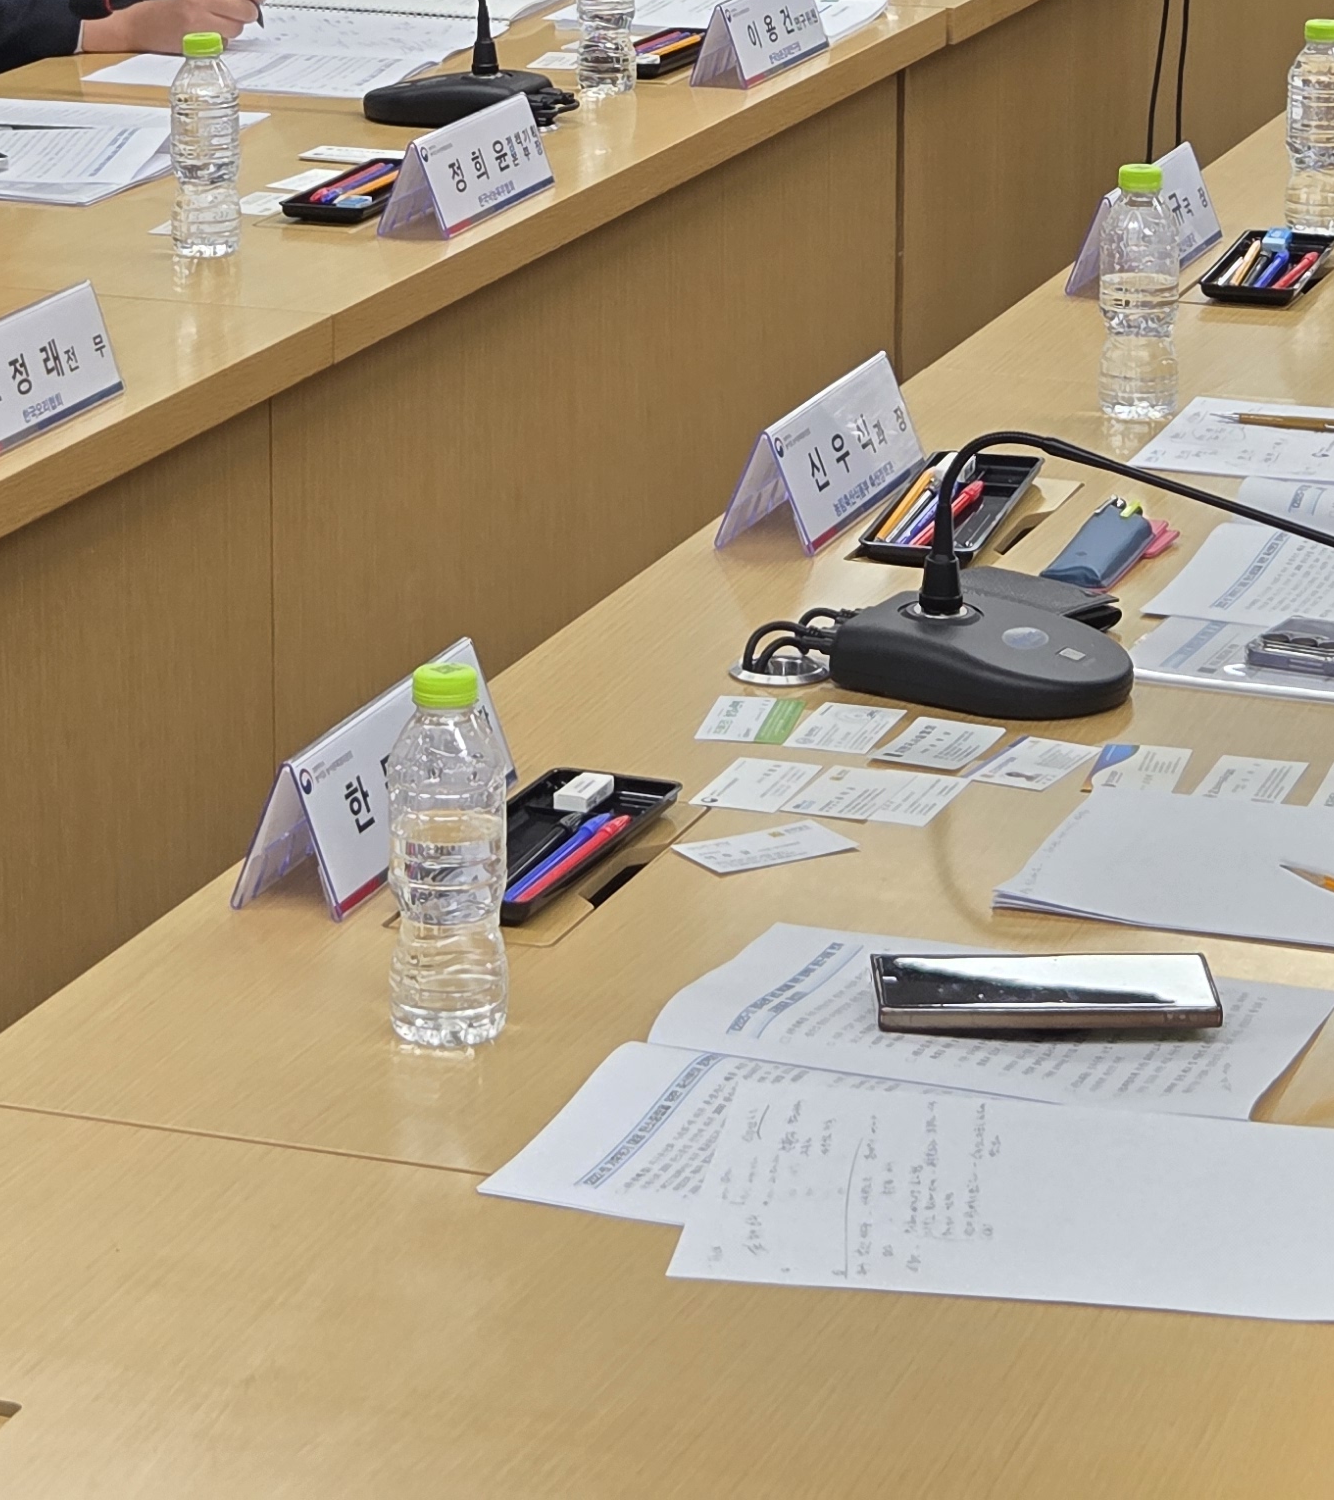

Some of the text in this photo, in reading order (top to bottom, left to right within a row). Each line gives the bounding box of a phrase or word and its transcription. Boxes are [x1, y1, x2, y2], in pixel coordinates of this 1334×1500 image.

[747, 5, 796, 49] 이용건
[448, 139, 511, 194] 정희윤
[64, 334, 106, 374] 전무
